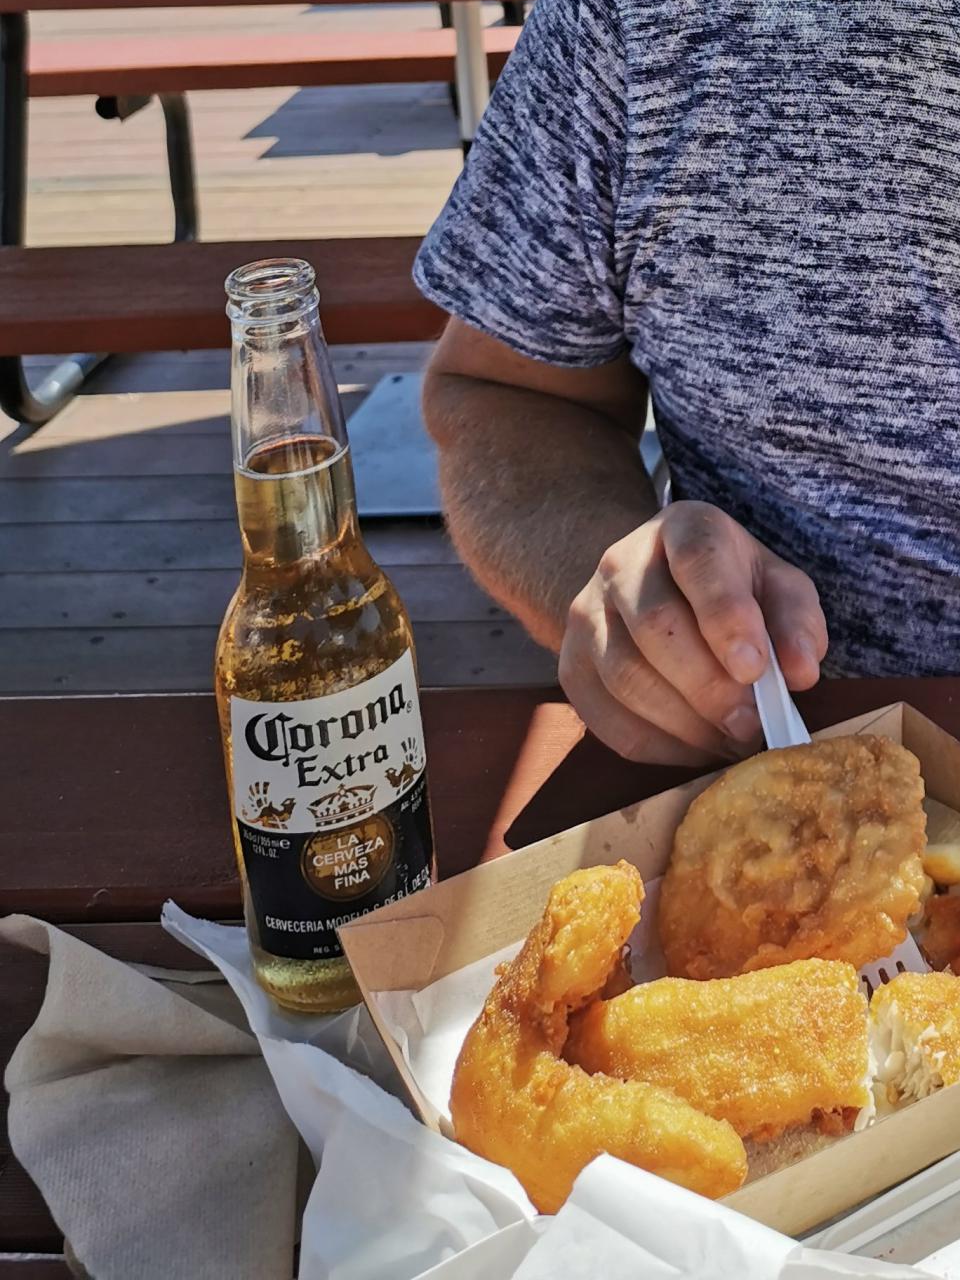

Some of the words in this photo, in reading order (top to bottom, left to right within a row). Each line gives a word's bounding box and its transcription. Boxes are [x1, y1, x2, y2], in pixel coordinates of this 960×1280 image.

[244, 682, 406, 768] Corona
[294, 744, 390, 788] Extra
[336, 833, 360, 849] LA
[312, 836, 385, 868] CERVEZA
[334, 856, 369, 877] MAS
[334, 869, 371, 890] FINA
[265, 915, 325, 933] CERVECERIA
